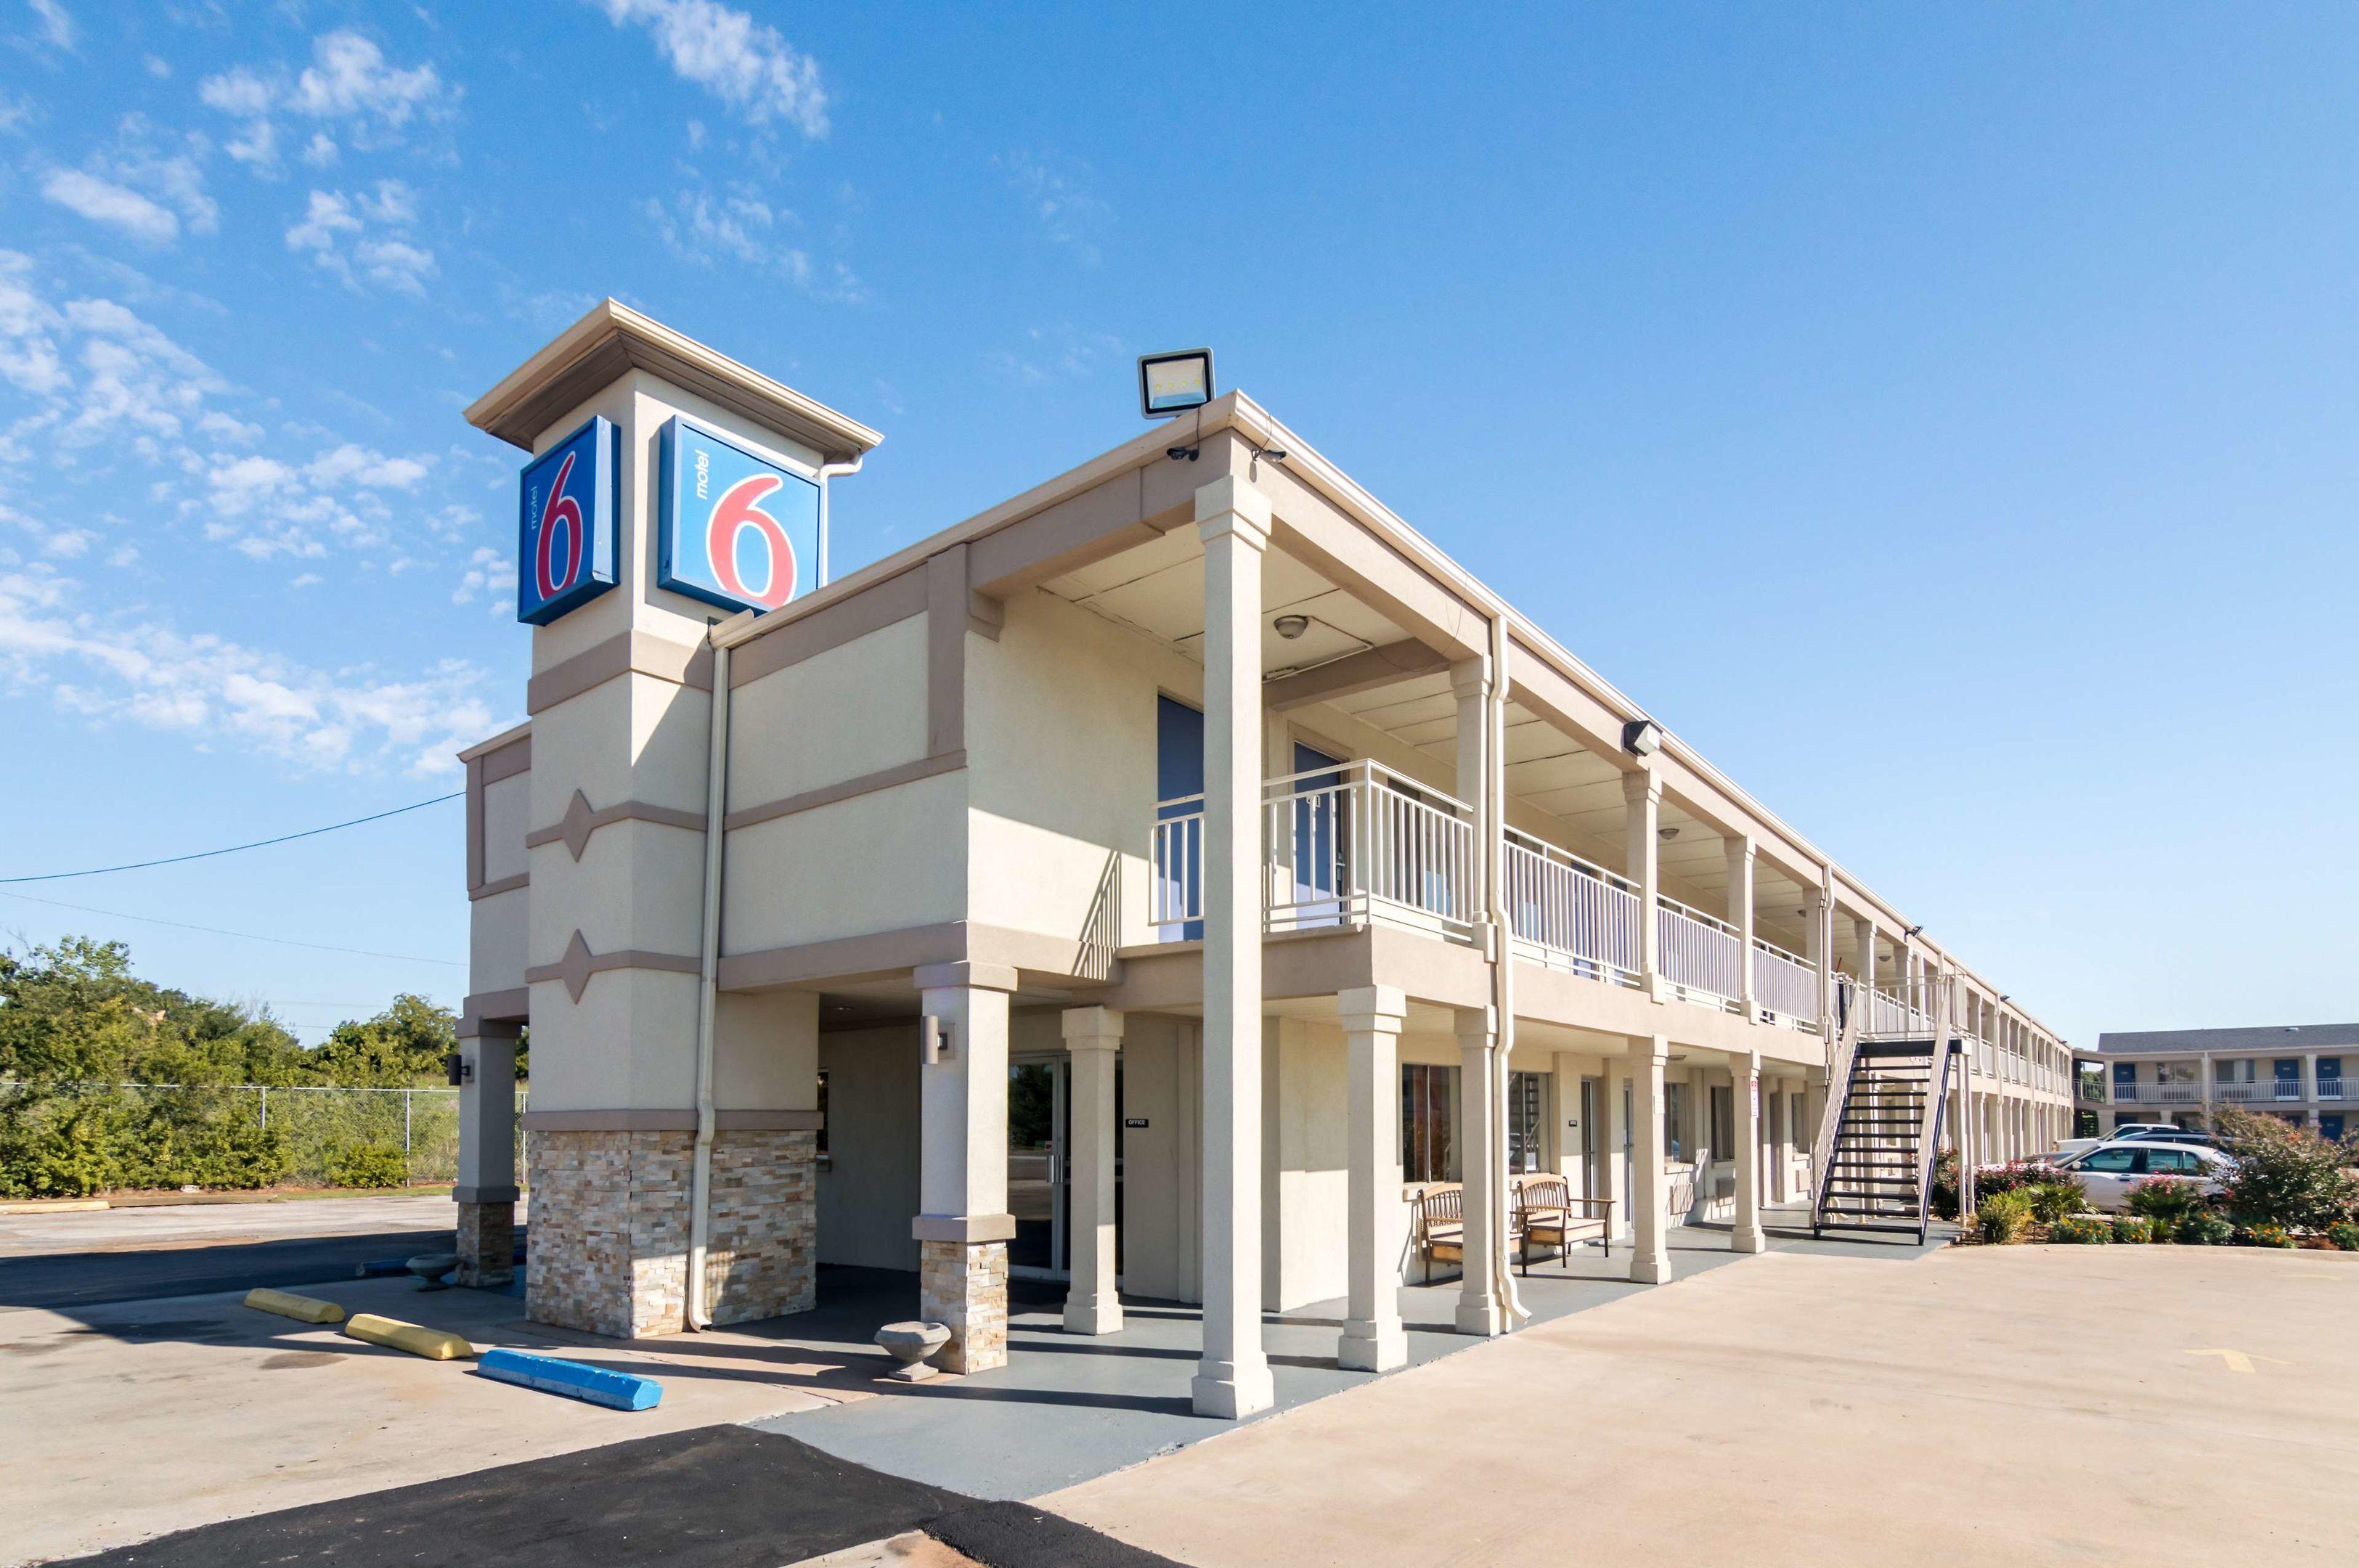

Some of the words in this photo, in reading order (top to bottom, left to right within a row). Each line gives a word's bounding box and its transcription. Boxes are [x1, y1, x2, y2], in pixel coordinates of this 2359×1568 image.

[536, 450, 583, 601] 6
[695, 449, 709, 499] motel
[706, 473, 797, 607] 6
